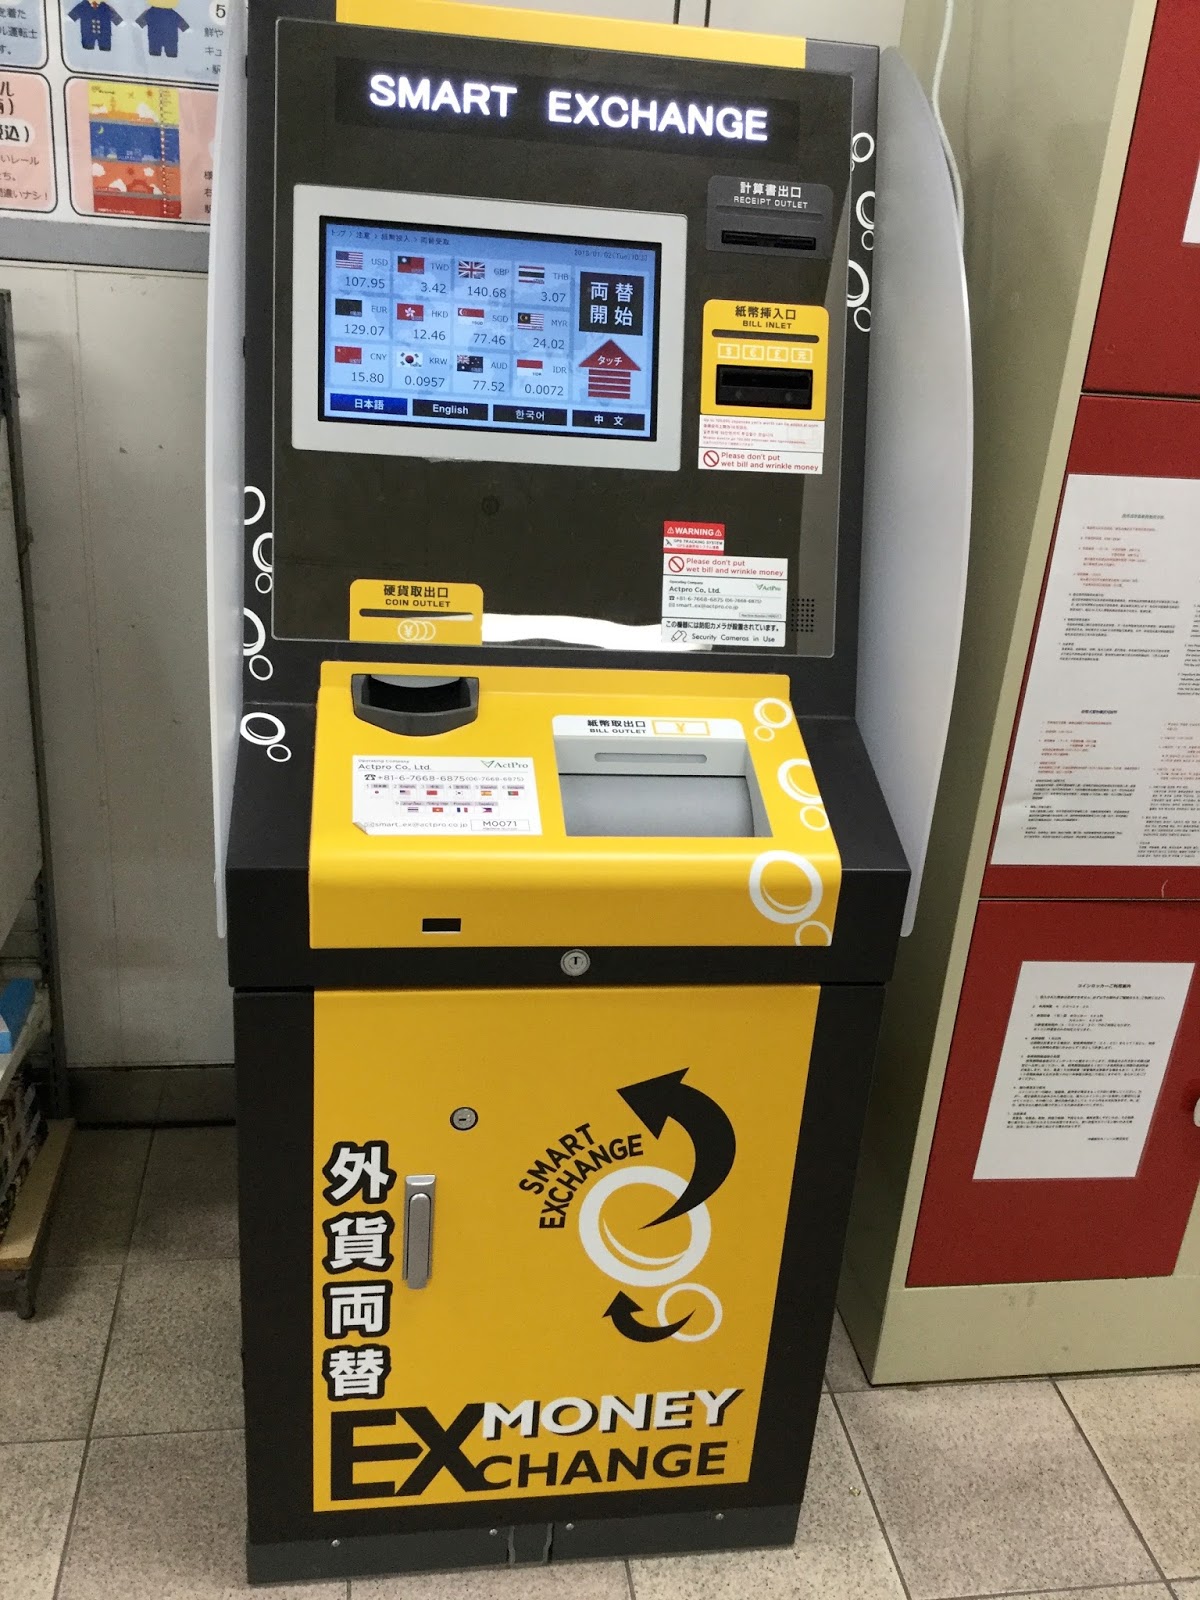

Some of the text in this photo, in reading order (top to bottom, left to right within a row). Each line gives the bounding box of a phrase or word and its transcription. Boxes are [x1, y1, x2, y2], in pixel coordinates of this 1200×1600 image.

[215, 4, 226, 19] 5
[369, 73, 769, 142] SMART EXCHANGE
[740, 181, 801, 198] 計算書出口
[733, 196, 808, 209] RECEIPT OUTLET
[371, 258, 388, 266] USD
[431, 263, 449, 271] TWD
[493, 268, 509, 276] GBP
[345, 276, 385, 289] 107.95
[421, 282, 446, 294] 3.42
[467, 286, 507, 298] 140.68
[541, 291, 566, 303] 3.07
[590, 281, 634, 303] 両替
[371, 305, 388, 314] EUR
[431, 310, 449, 319] HKD
[735, 305, 796, 320] 紙幣挿入口
[492, 315, 509, 323] SGD
[590, 305, 633, 327] 開始
[551, 319, 568, 327] MYR
[742, 320, 792, 330] BILL INLET
[344, 324, 385, 336] 129.07
[413, 329, 446, 341] 12.46
[473, 333, 506, 346] 77.46
[533, 338, 565, 350] 24.02
[370, 353, 387, 361] CNY
[429, 357, 448, 365] KRW
[597, 355, 623, 367] タッチ
[491, 362, 508, 370] AUD
[552, 366, 567, 374] IDR
[351, 372, 385, 384] 15.80
[404, 375, 445, 388] 0.0957
[472, 380, 505, 392] 77.52
[524, 383, 564, 396] 0.0072
[354, 398, 384, 411] 日本語
[432, 403, 469, 415] English
[515, 409, 545, 421] 한국어
[721, 452, 780, 462] Please don't put
[750, 461, 764, 469] and
[766, 462, 792, 470] wrinkle
[794, 464, 819, 472] money
[675, 526, 714, 536] WARNING
[712, 558, 731, 566] don't
[383, 584, 449, 598] 硬貨取出口
[413, 600, 450, 608] OUTLET
[692, 634, 717, 642] Security
[587, 719, 647, 728] 紙幣取出口
[518, 1122, 597, 1195] SMART
[538, 1133, 644, 1229] EXCHANGE
[327, 1144, 392, 1398] 外貨両替
[482, 1388, 745, 1441] MONEY
